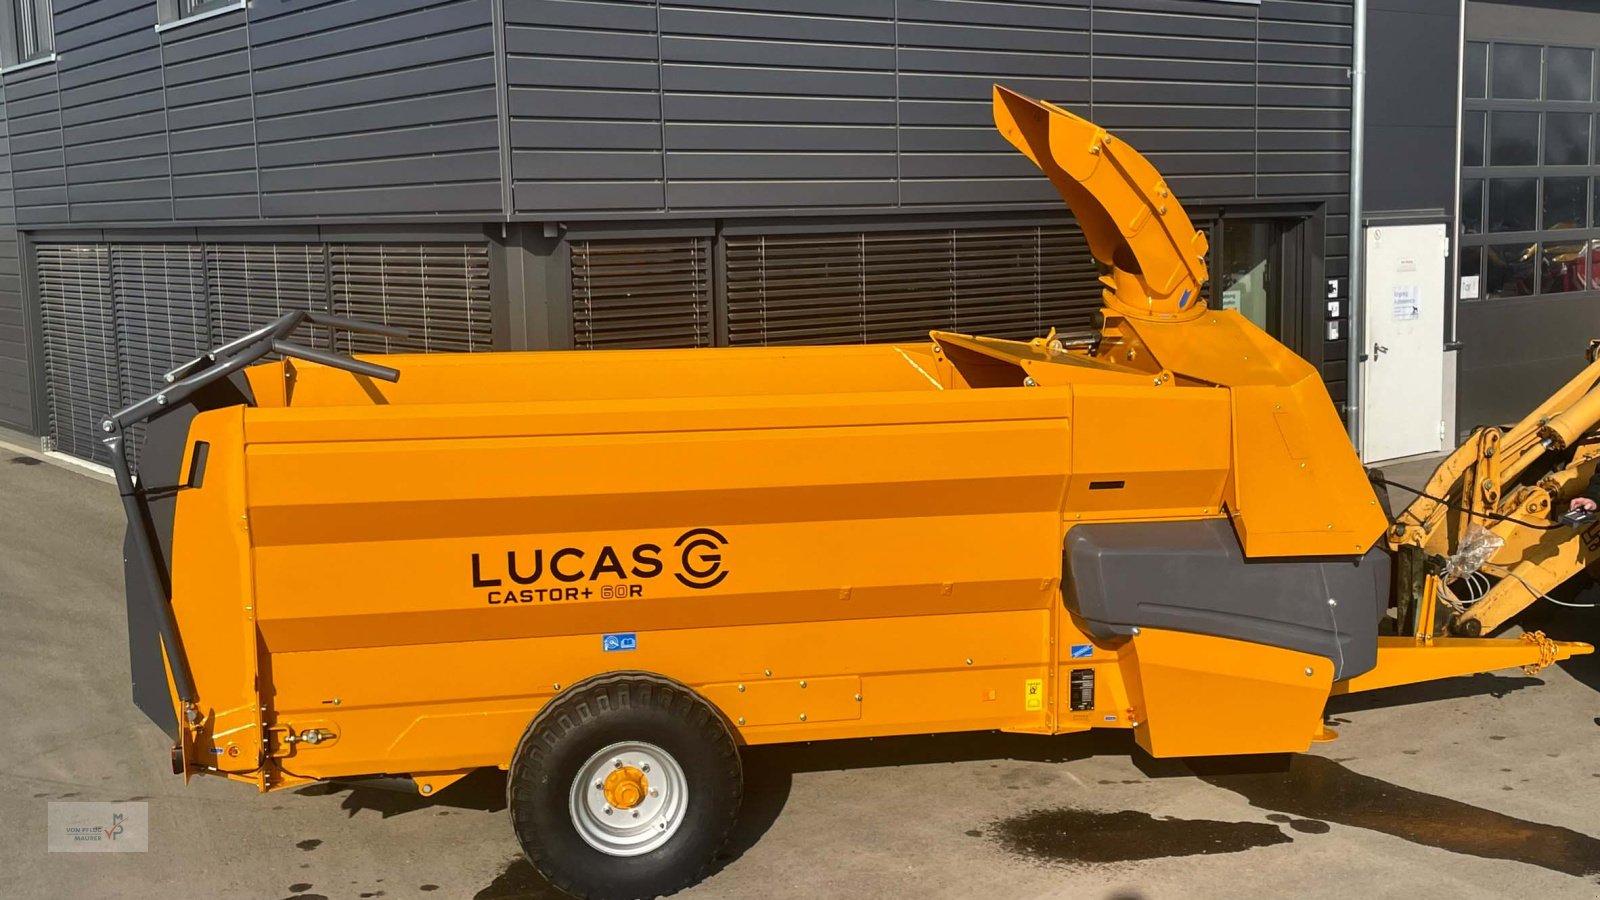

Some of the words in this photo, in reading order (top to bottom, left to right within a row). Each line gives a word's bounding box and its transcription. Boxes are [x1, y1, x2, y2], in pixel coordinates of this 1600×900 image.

[471, 543, 664, 588] LUCAS
[487, 586, 593, 604] CASTOR+
[600, 584, 644, 599] 60R
